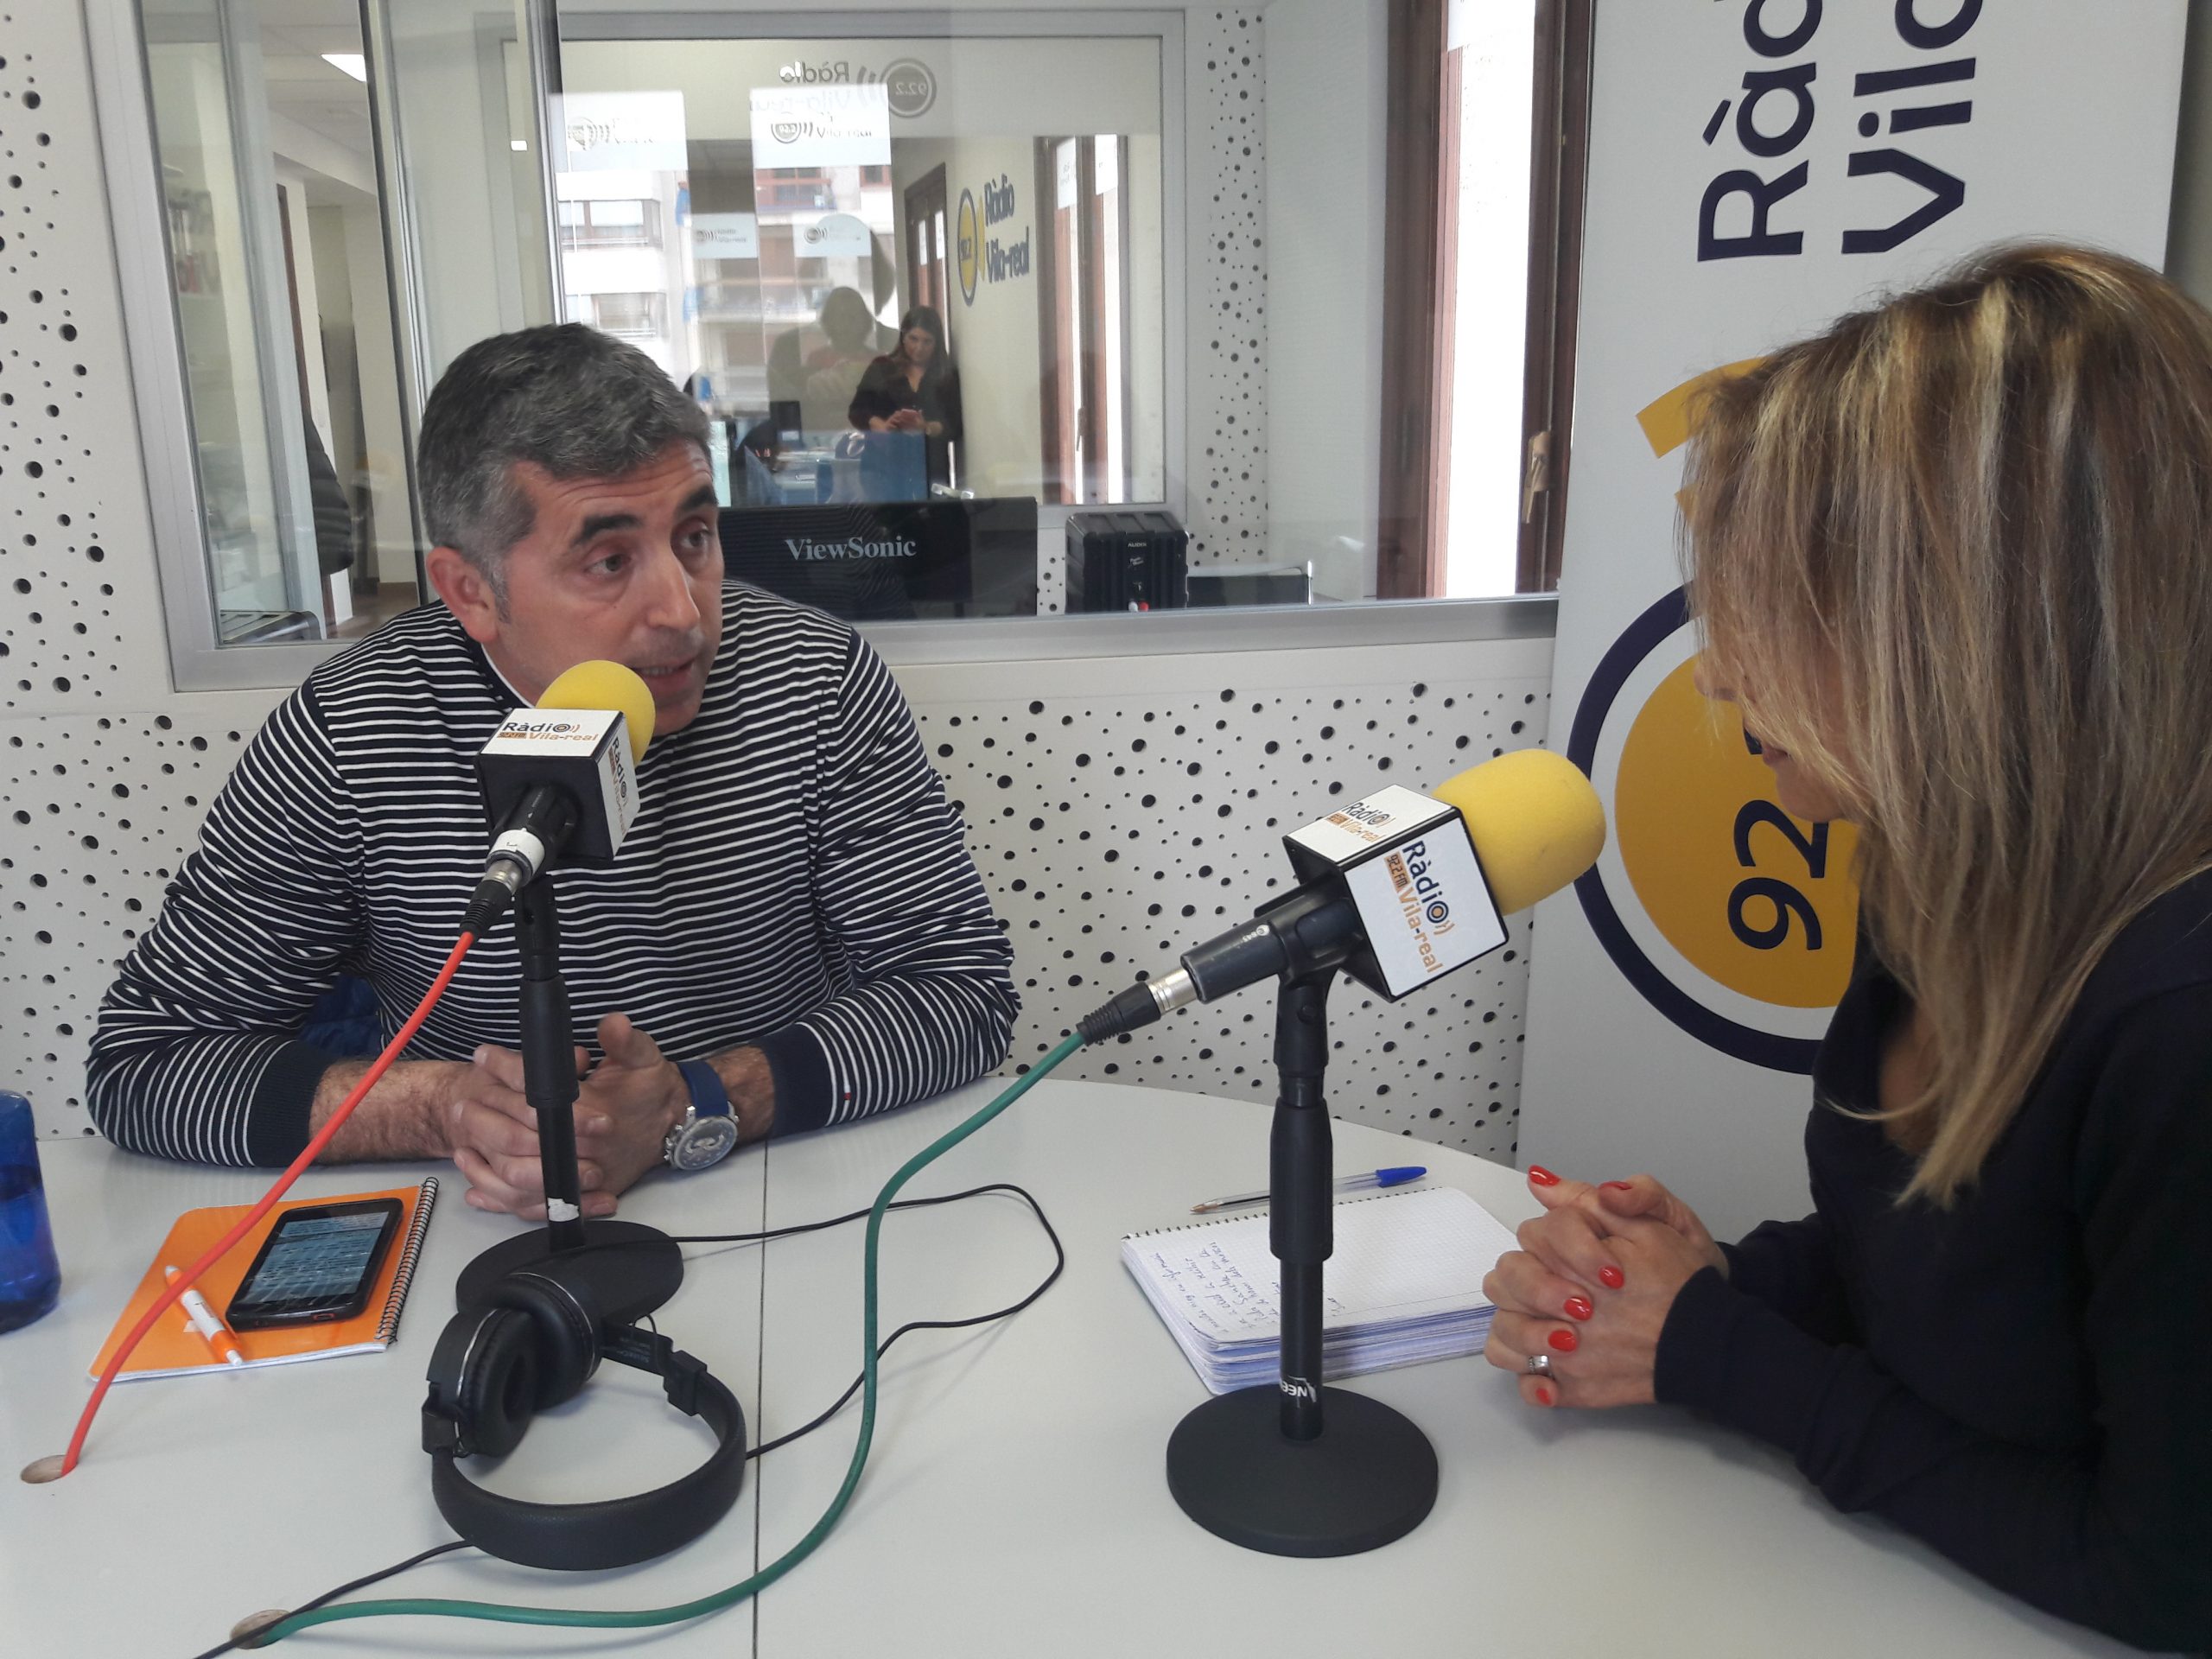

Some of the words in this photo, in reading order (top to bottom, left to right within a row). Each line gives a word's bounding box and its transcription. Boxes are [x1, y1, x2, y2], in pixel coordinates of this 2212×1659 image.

[986, 226, 1029, 283] Vila-real
[785, 535, 917, 561] ViewSonic
[502, 722, 571, 733] Ràdio
[529, 732, 599, 741] Vila-real
[1728, 724, 1829, 950] 92
[1402, 840, 1449, 925] Ràdio
[1398, 887, 1443, 973] Vila-real
